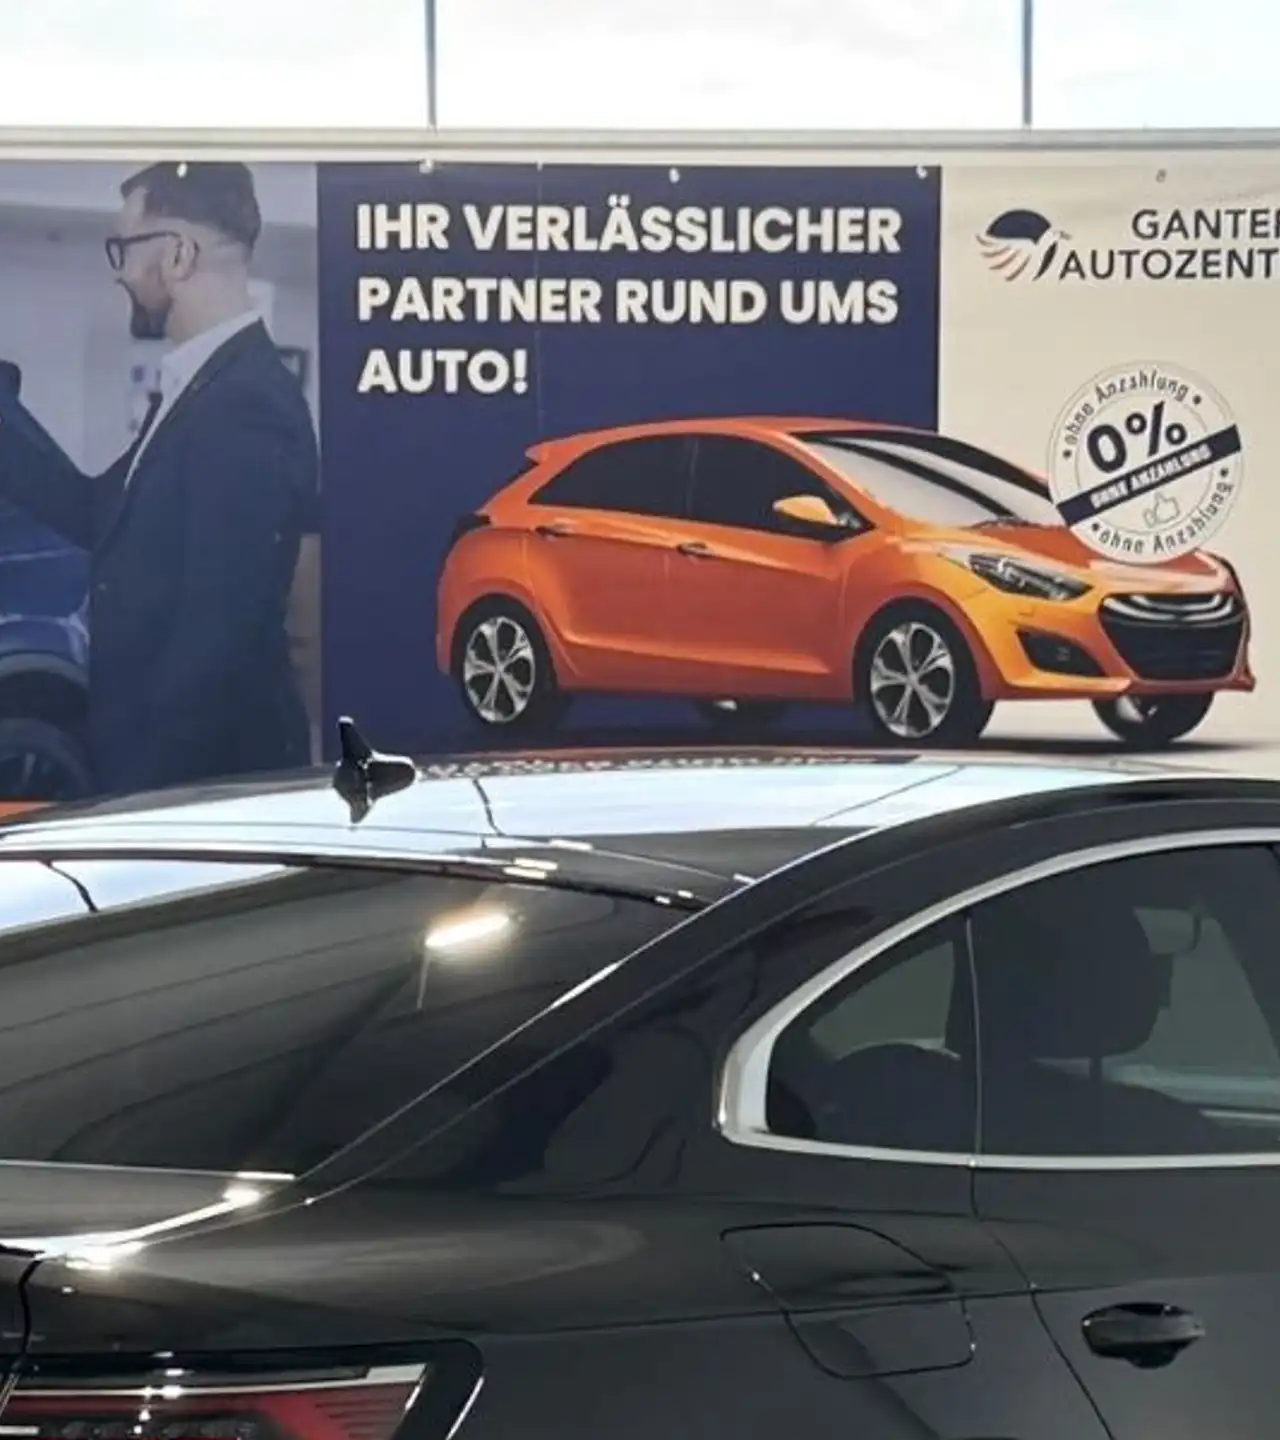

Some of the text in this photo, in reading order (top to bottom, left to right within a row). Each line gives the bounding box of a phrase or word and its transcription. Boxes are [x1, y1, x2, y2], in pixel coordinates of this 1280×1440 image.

[356, 194, 903, 254] IHR VERLÄSSLICHER
[357, 277, 899, 325] PARTNER RUND UMS
[357, 349, 528, 394] AUTO!
[1064, 369, 1190, 445] ohne Anzahlung
[1086, 400, 1188, 474] 0%
[1099, 479, 1235, 555] ohne Anzahlung
